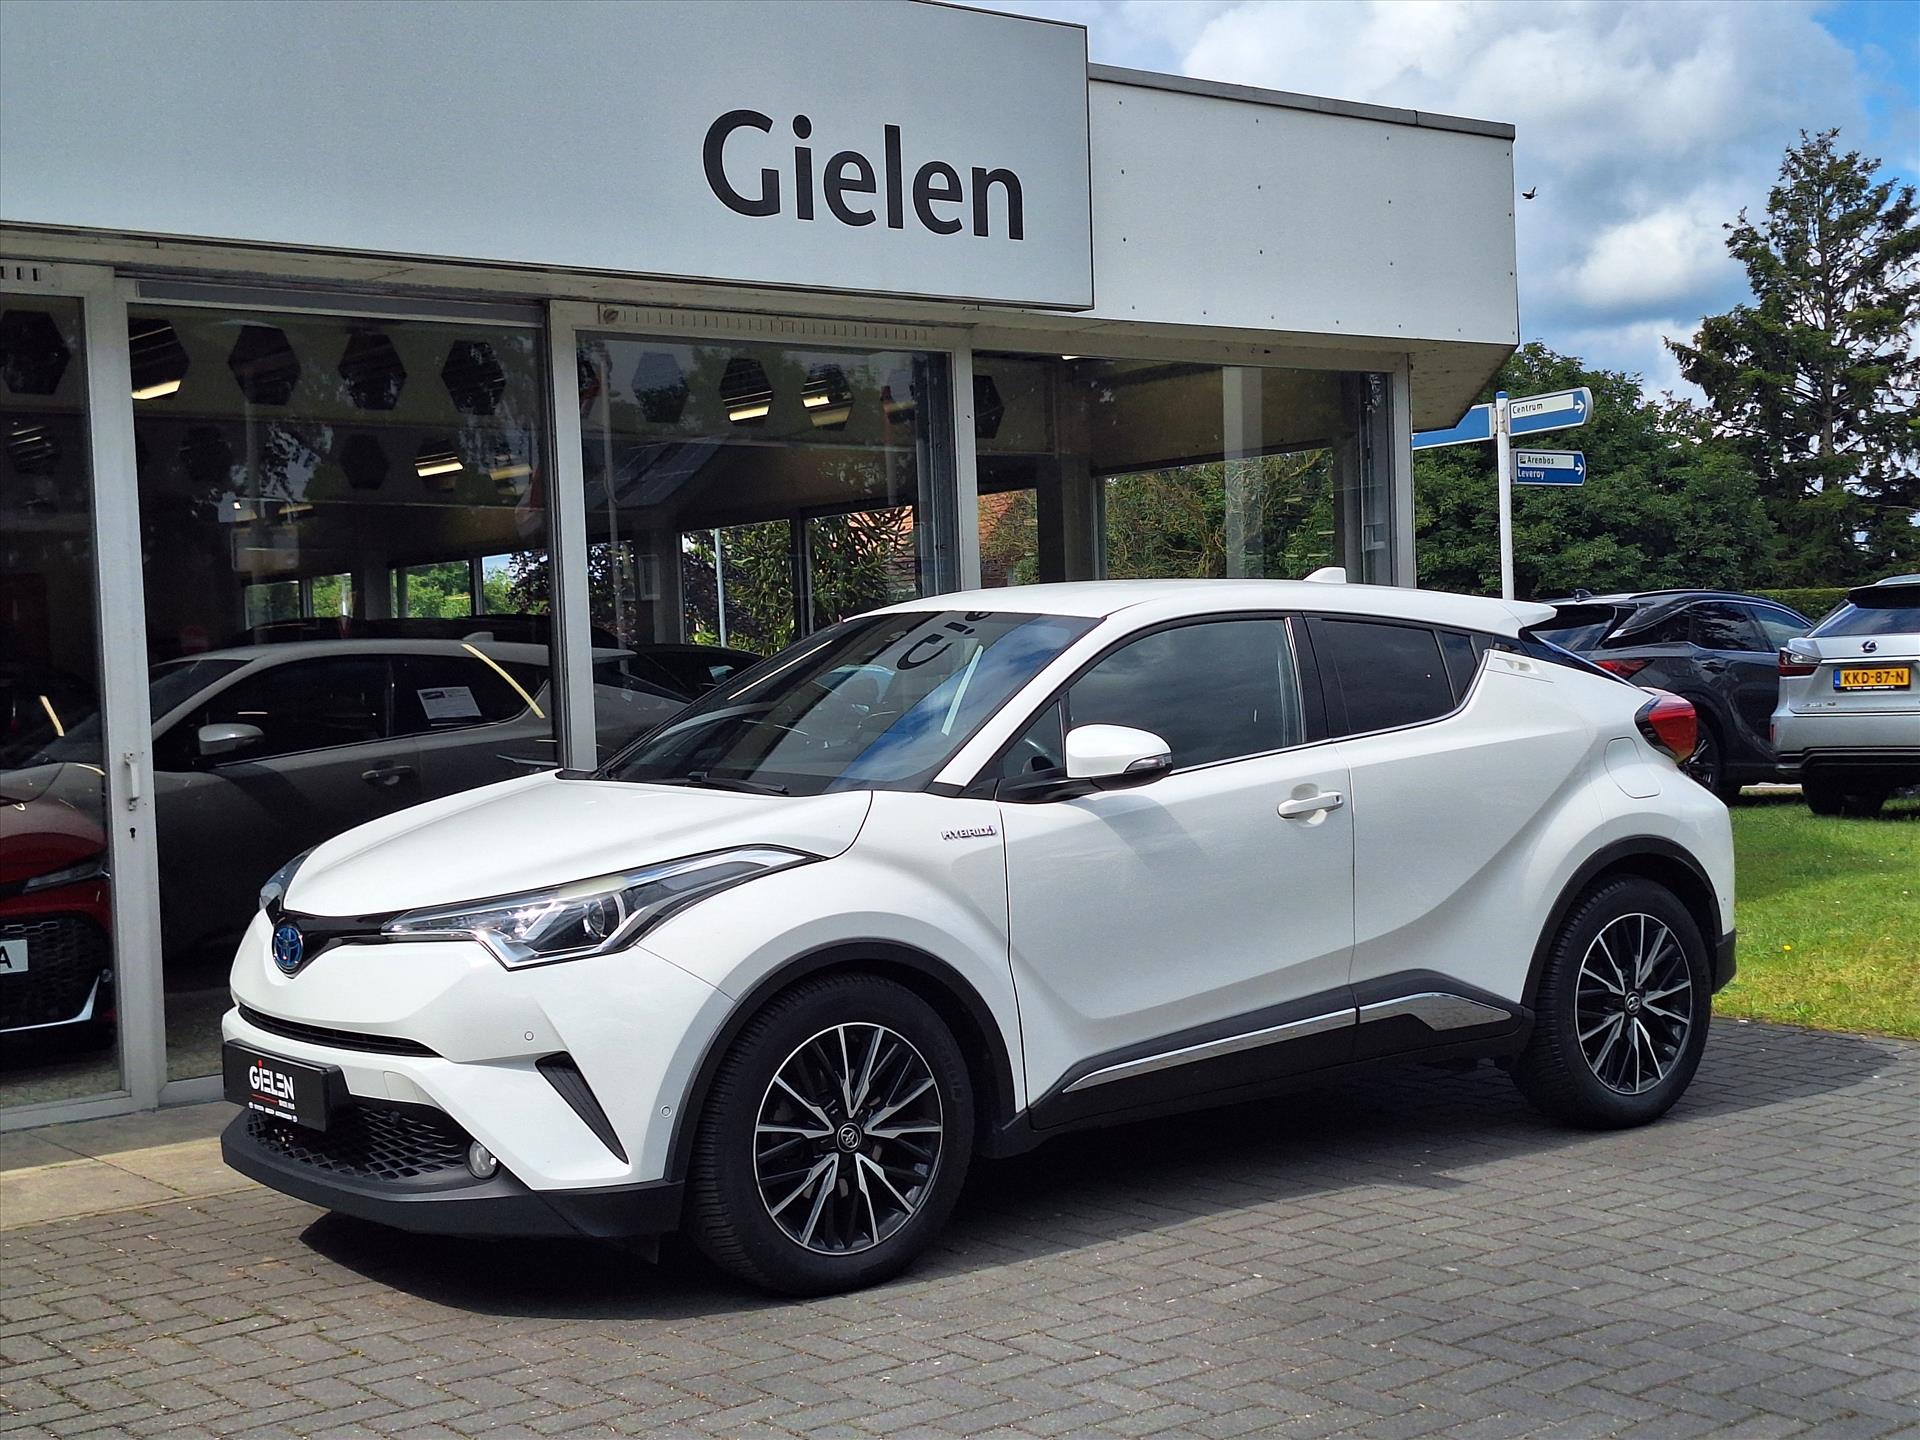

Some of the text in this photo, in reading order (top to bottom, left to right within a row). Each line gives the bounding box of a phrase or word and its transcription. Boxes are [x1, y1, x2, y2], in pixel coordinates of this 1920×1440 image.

[703, 109, 1024, 241] Gielen
[1512, 403, 1543, 414] Centrum
[1517, 468, 1545, 480] Leveroy
[1843, 670, 1905, 685] KKD-87-N
